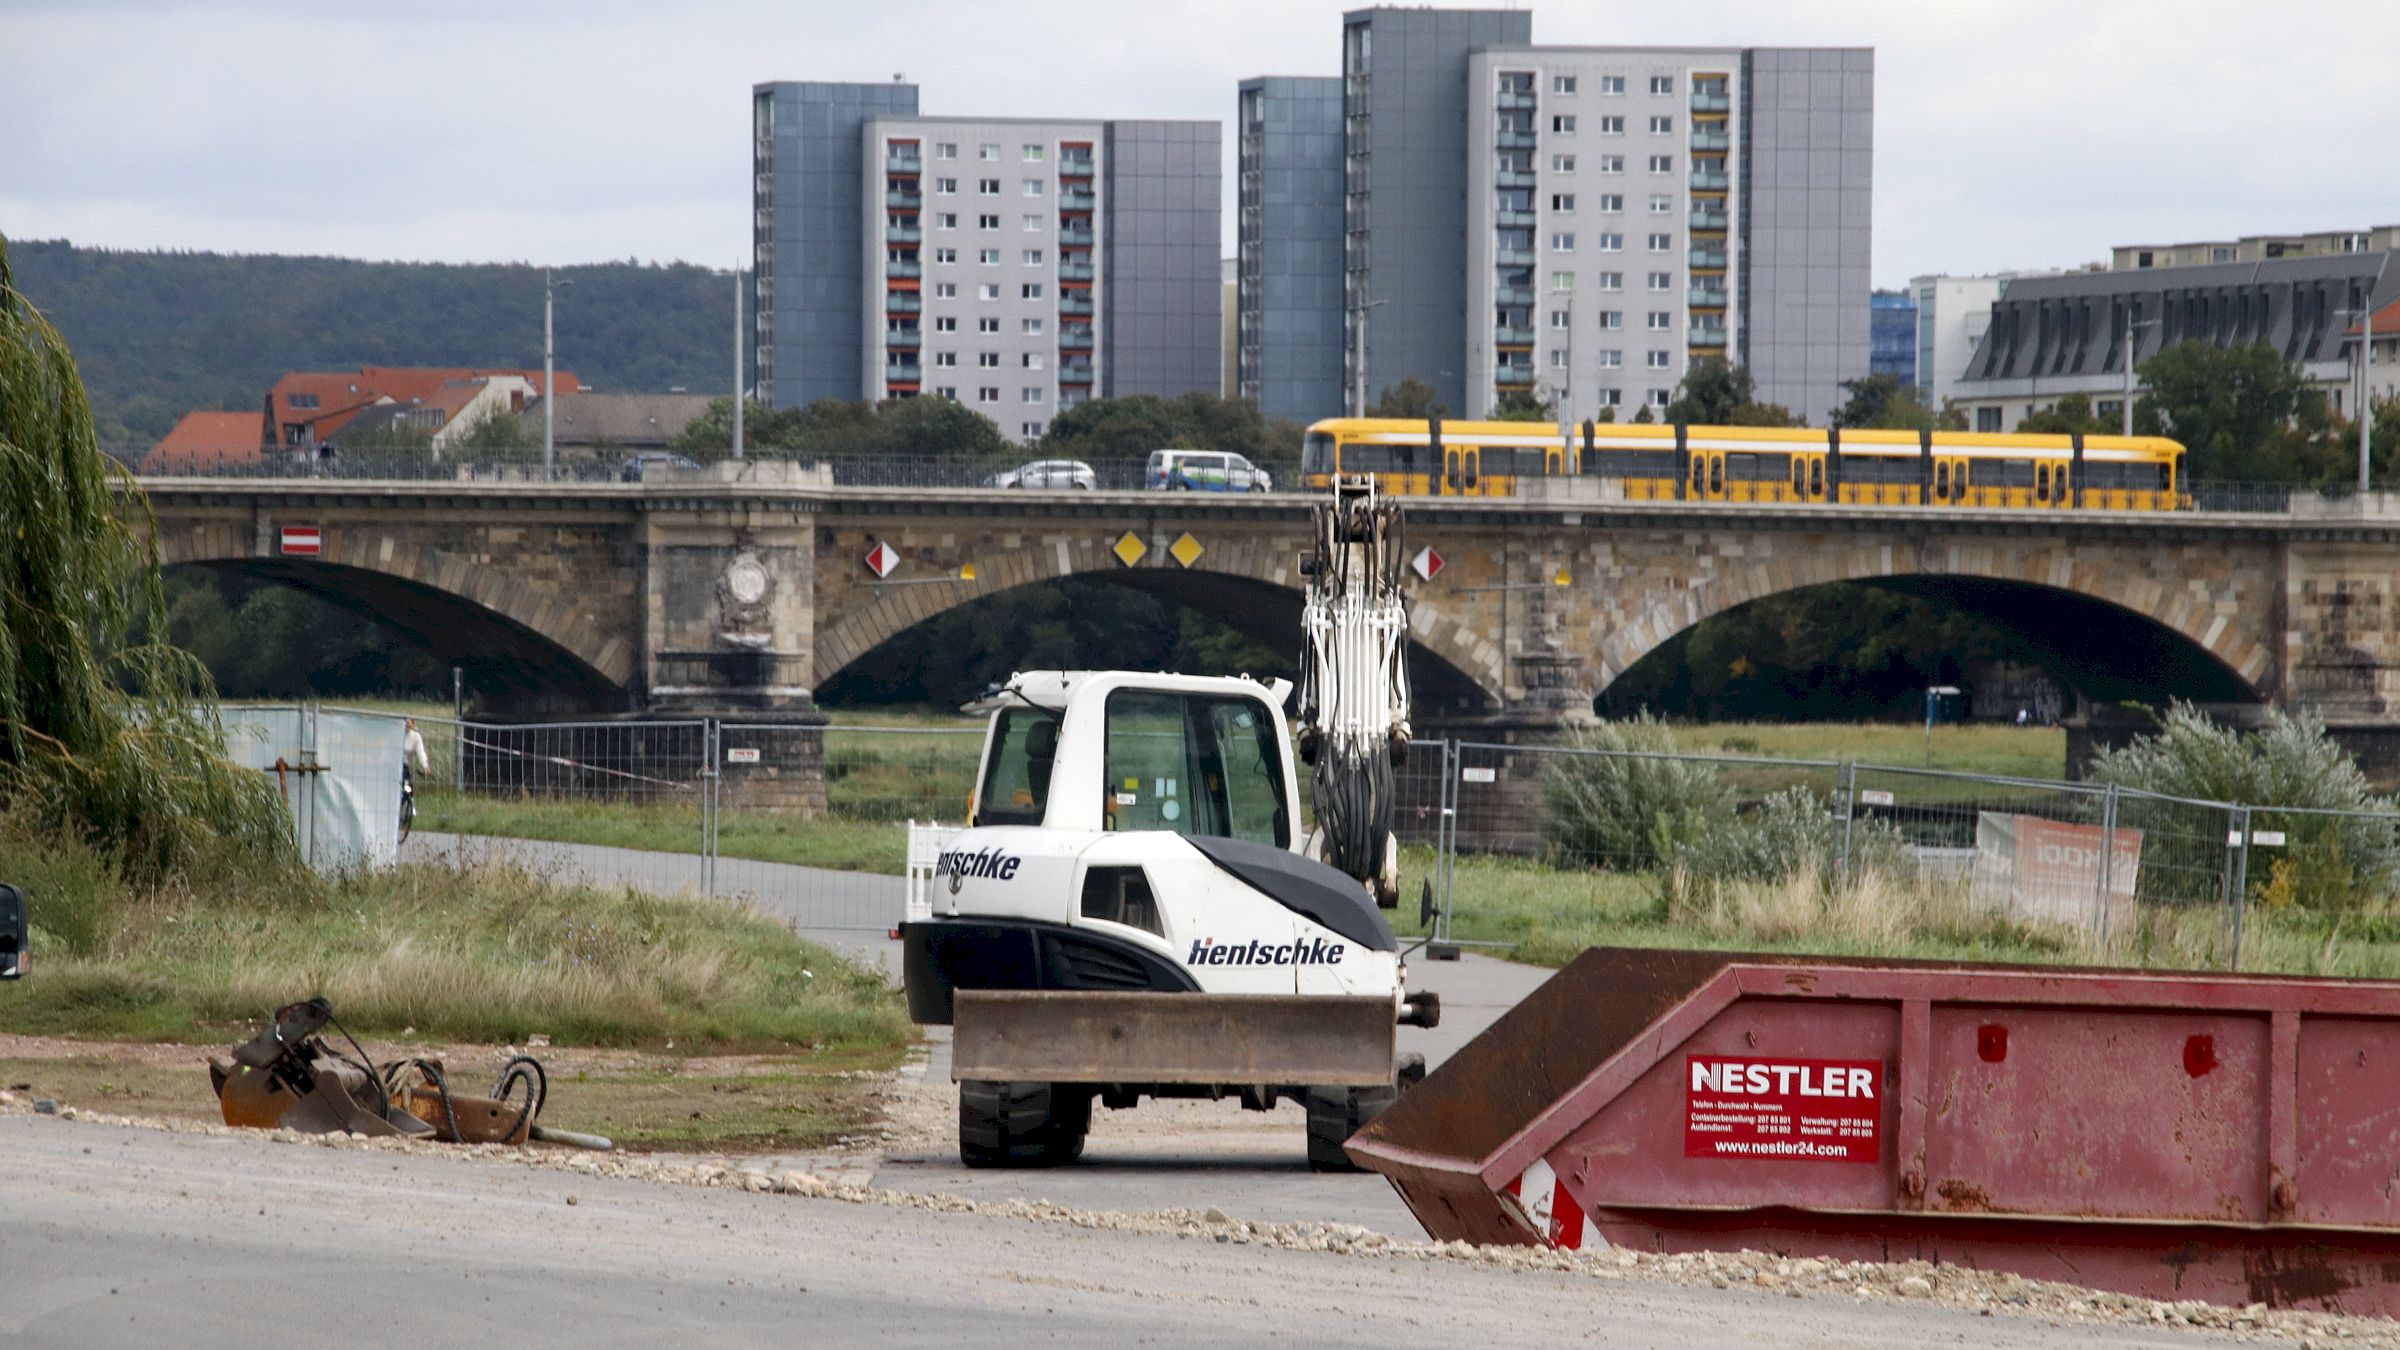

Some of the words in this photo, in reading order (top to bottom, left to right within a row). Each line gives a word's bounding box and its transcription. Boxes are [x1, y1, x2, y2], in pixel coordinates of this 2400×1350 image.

[936, 846, 1021, 880] entschke
[1188, 937, 1345, 966] Hentschke
[1692, 1061, 1874, 1099] NESTLER
[1715, 1141, 1848, 1157] www.nestler24.com
